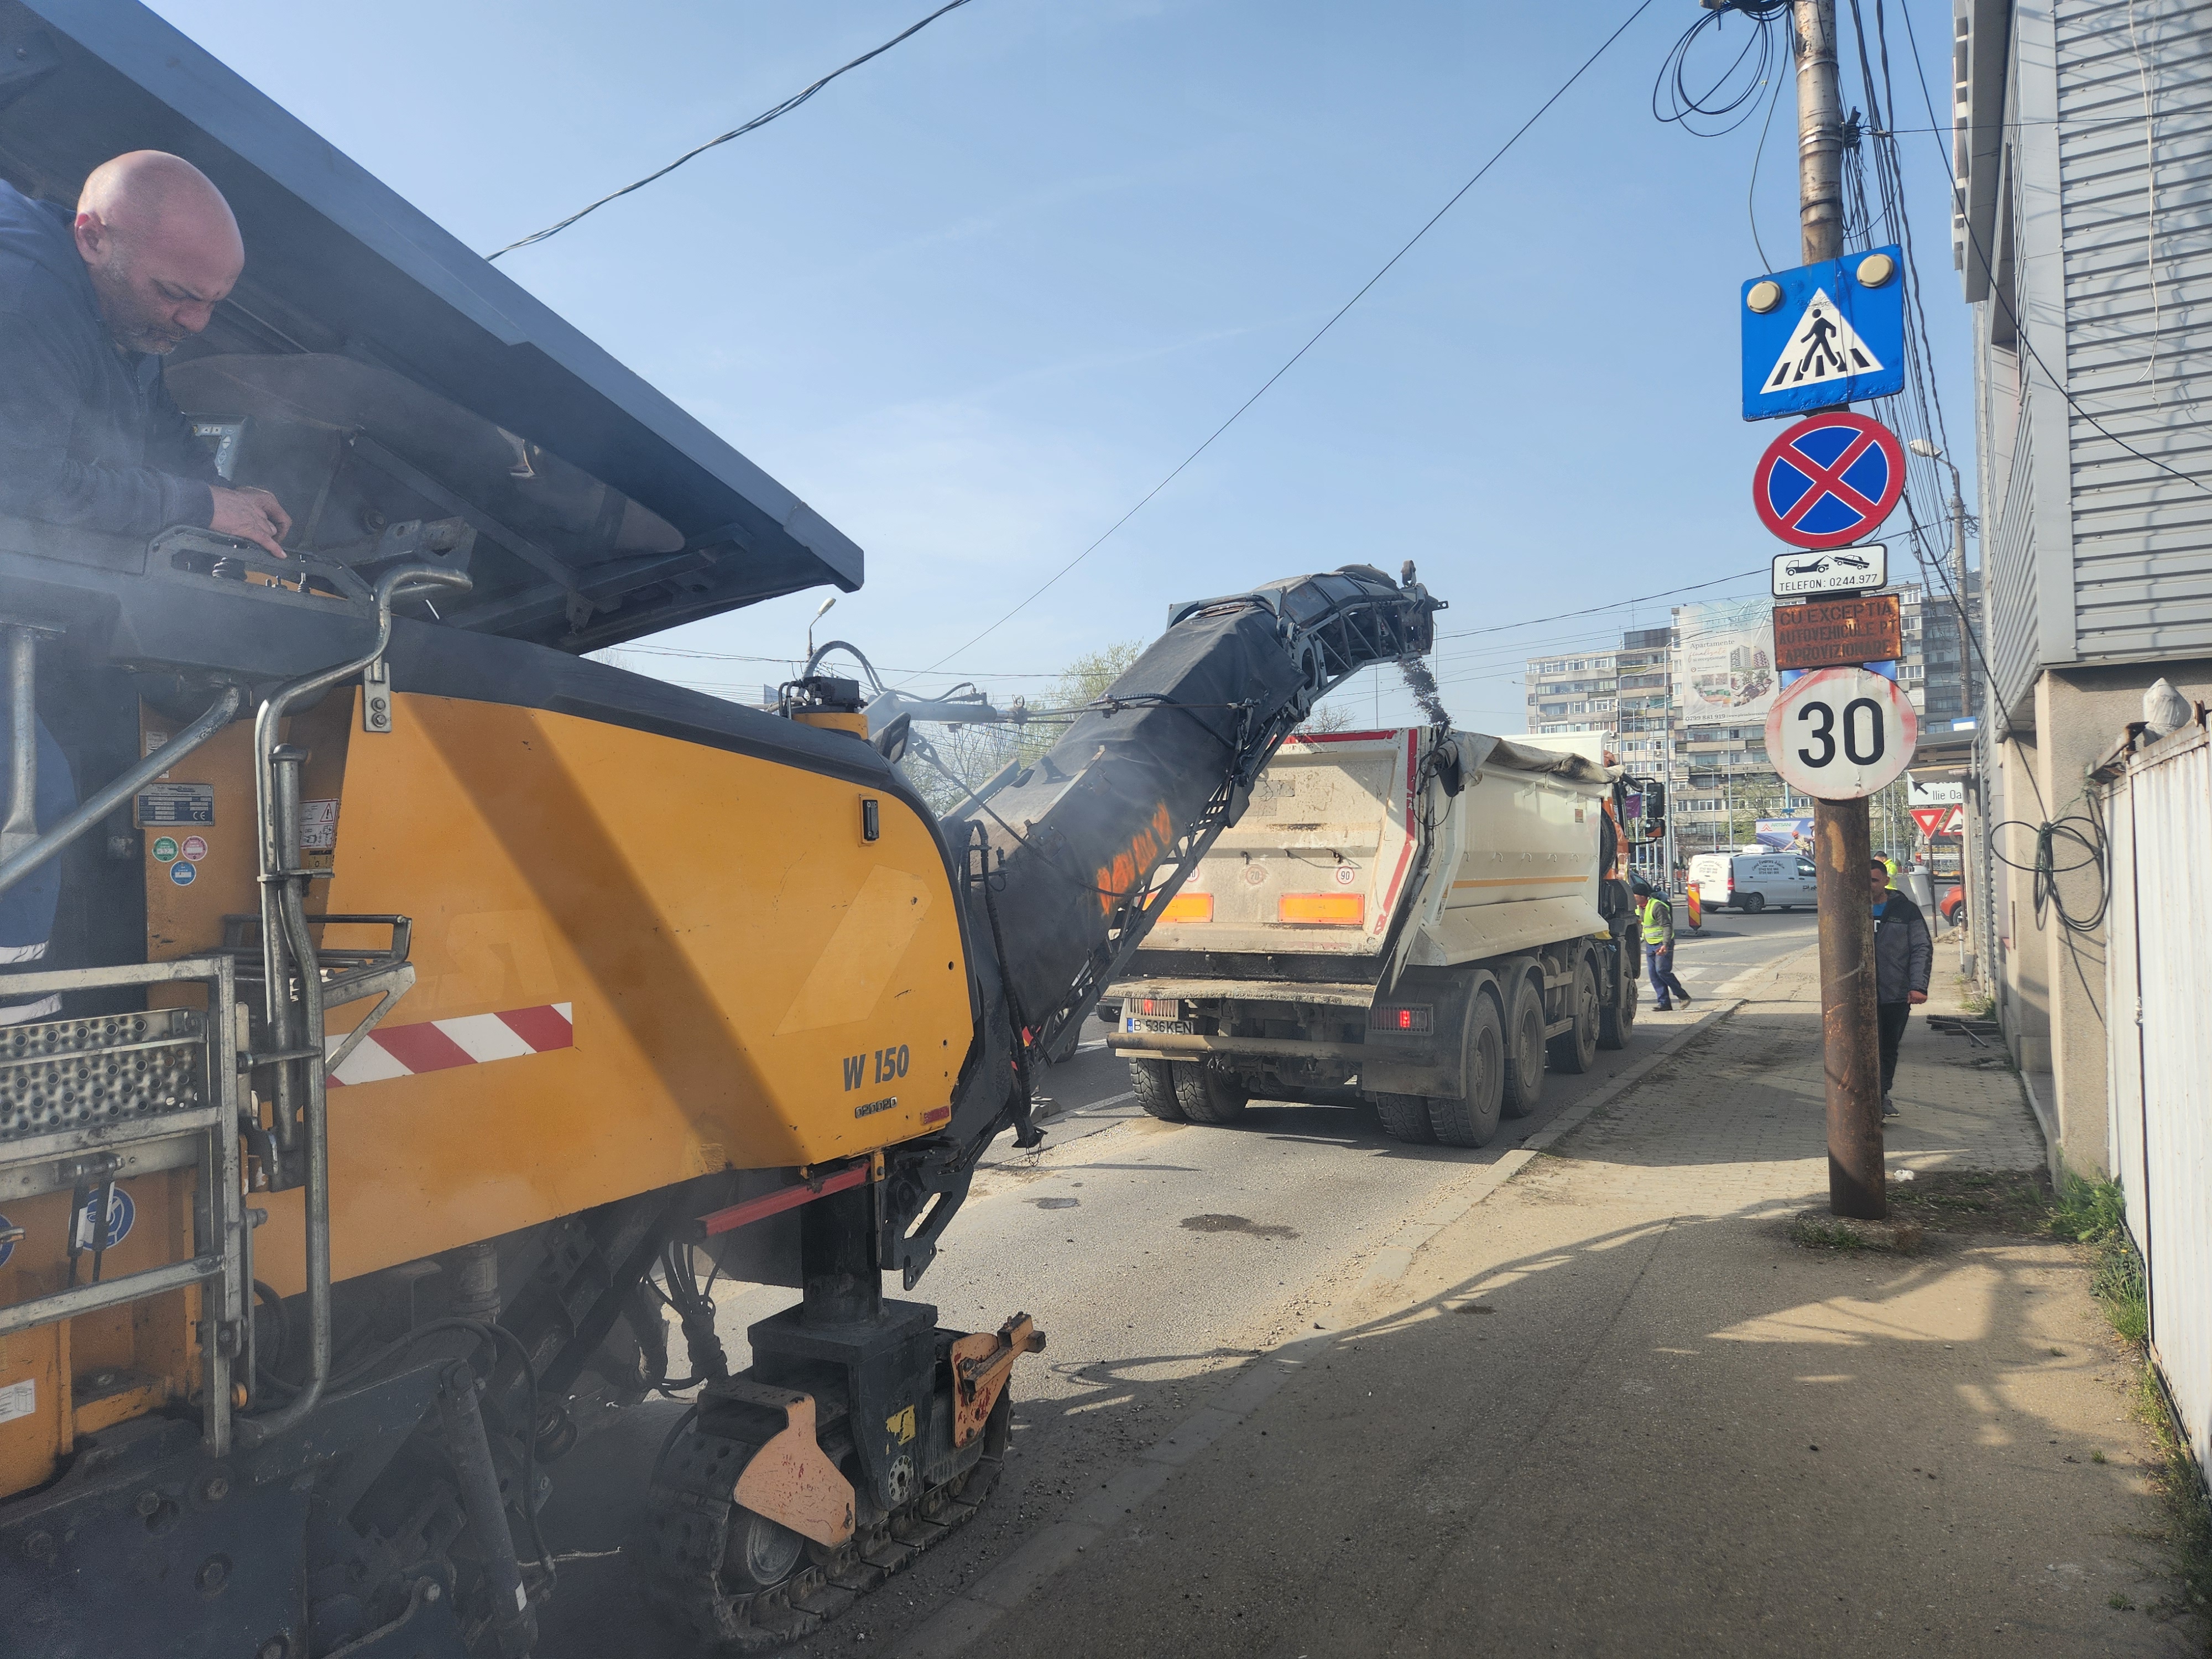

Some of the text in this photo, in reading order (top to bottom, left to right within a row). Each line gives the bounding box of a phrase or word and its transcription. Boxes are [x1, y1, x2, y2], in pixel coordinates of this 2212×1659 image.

[1780, 574, 1877, 591] TELEFON: 0244.977
[1780, 602, 1893, 625] CU EXCEPTIA
[1780, 622, 1874, 645] AUTOVEHICULE
[1690, 640, 1735, 650] Apartamente
[1786, 639, 1891, 662] APROVIZIONARE
[1688, 647, 1726, 662] finalizate
[1798, 698, 1884, 768] 30
[1933, 790, 1945, 800] Ilie
[1250, 871, 1259, 880] 70
[1341, 871, 1350, 880] 90
[1134, 1020, 1141, 1031] B
[843, 1044, 909, 1092] W 150
